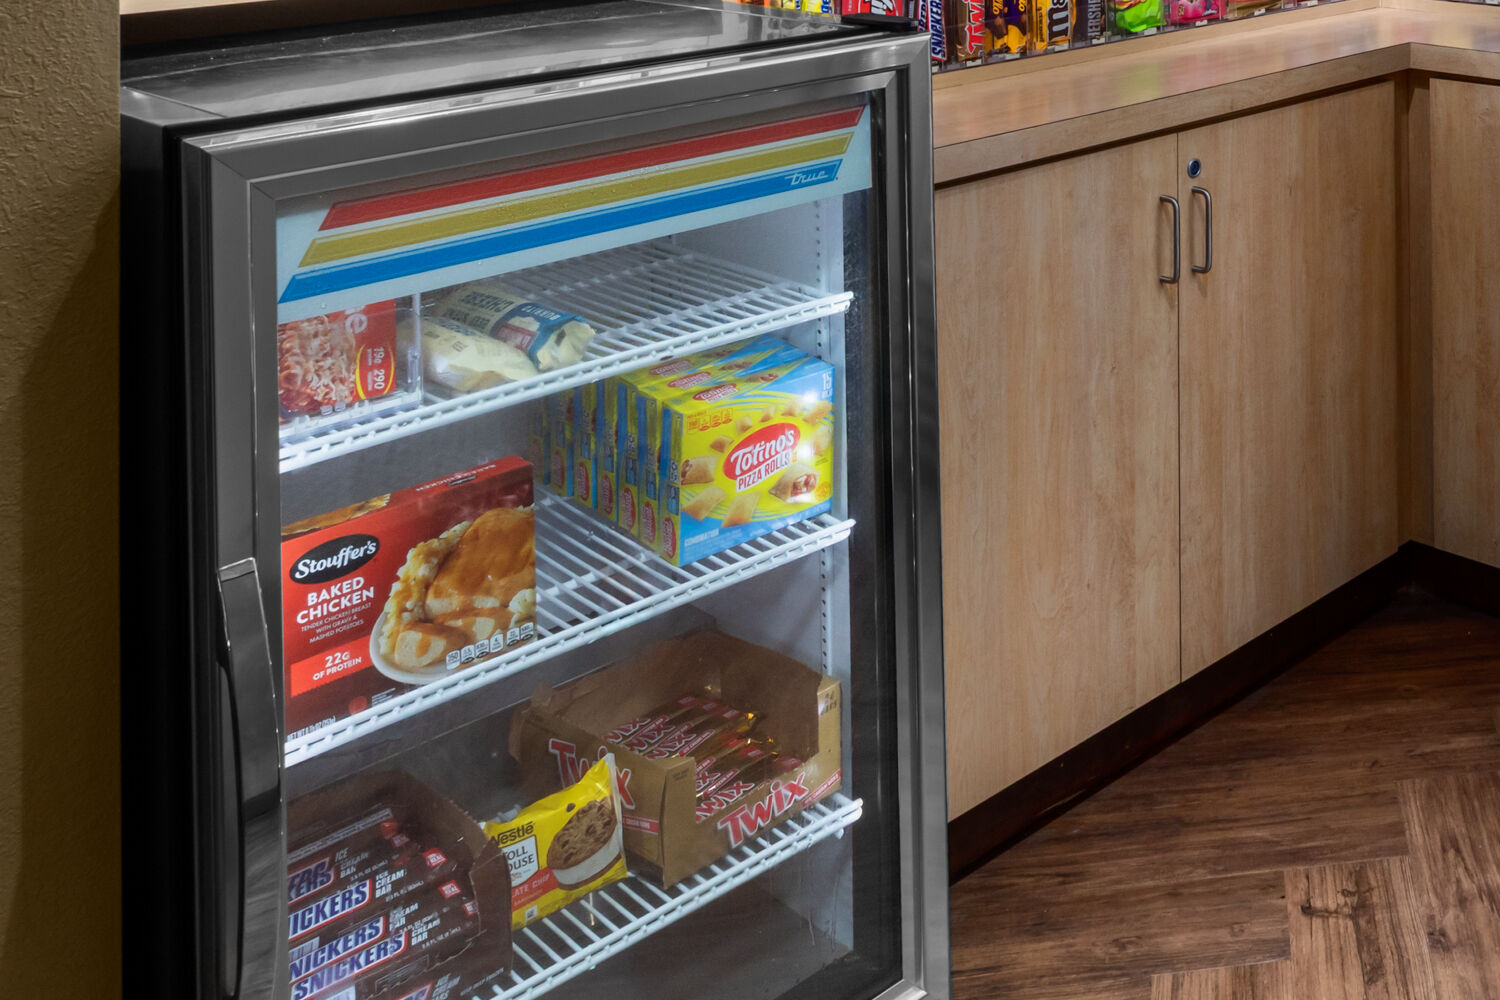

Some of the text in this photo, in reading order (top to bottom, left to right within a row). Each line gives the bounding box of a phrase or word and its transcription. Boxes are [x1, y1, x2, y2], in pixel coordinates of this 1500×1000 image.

[374, 367, 386, 391] 290
[730, 426, 796, 477] Totino's
[737, 453, 792, 491] PIZZA ROLLS
[294, 538, 377, 580] Stouffer's
[296, 586, 375, 625] CHICKEN
[306, 575, 366, 607] BAKED
[301, 602, 372, 633] TENDER CHICKEN BREAST
[309, 618, 364, 644] MASHED POTATOES
[315, 615, 351, 635] WITH GRAVY
[312, 655, 363, 682] OF PROTEIN
[375, 884, 392, 899] BAR
[376, 868, 406, 889] CREAM
[531, 873, 551, 888] CHIP
[292, 932, 405, 1000] SNICKERS
